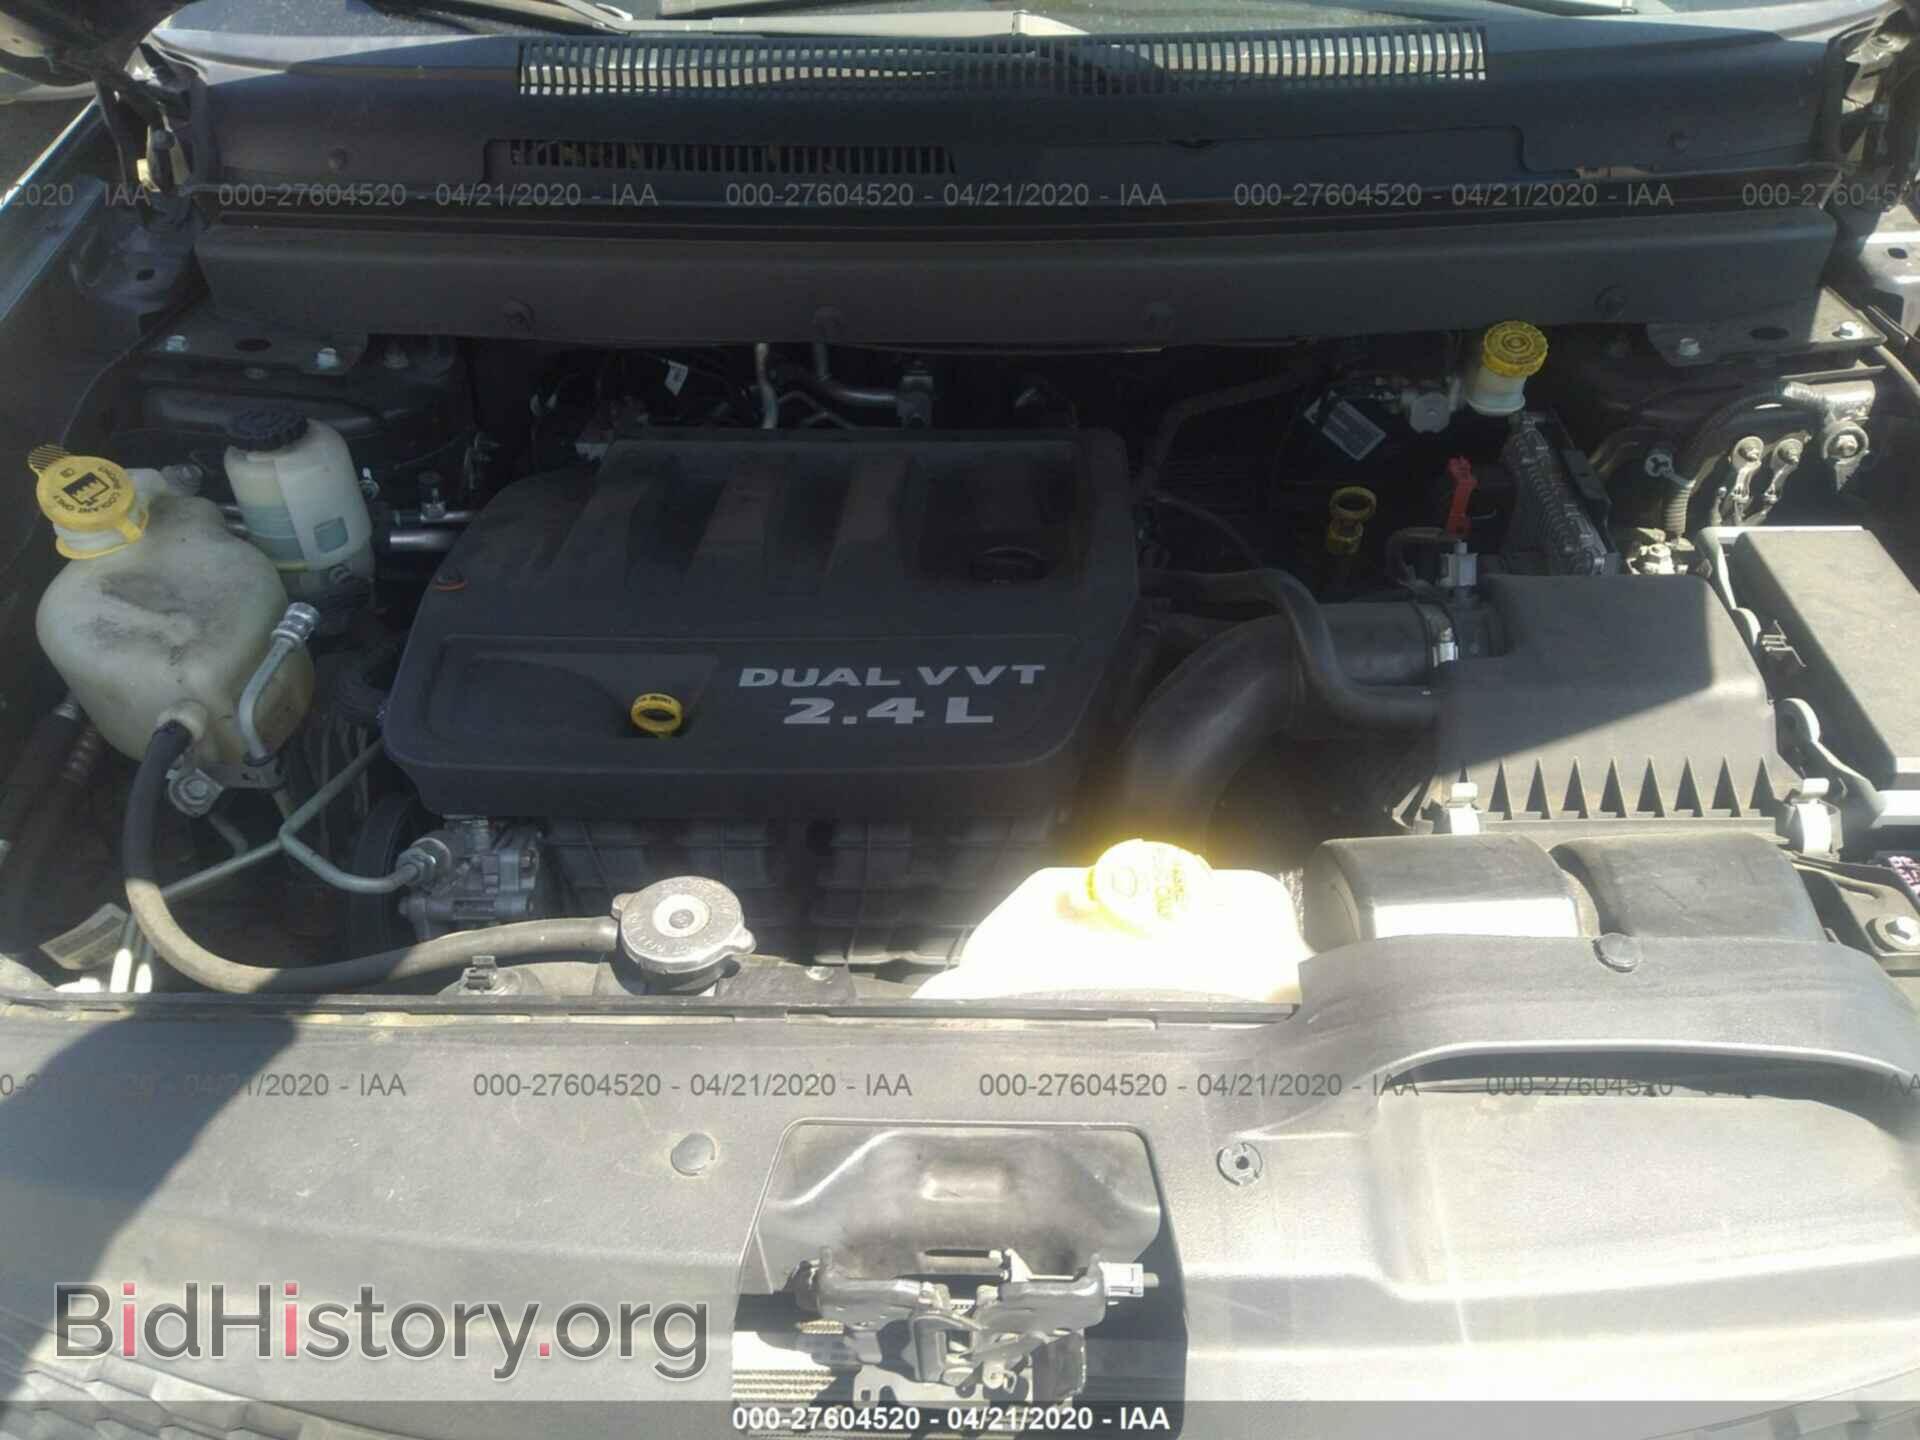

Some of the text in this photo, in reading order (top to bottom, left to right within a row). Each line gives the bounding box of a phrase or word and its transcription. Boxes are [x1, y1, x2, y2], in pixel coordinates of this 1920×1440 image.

[739, 664, 1046, 687] DUAL VVT
[784, 696, 994, 724] 2.4 L
